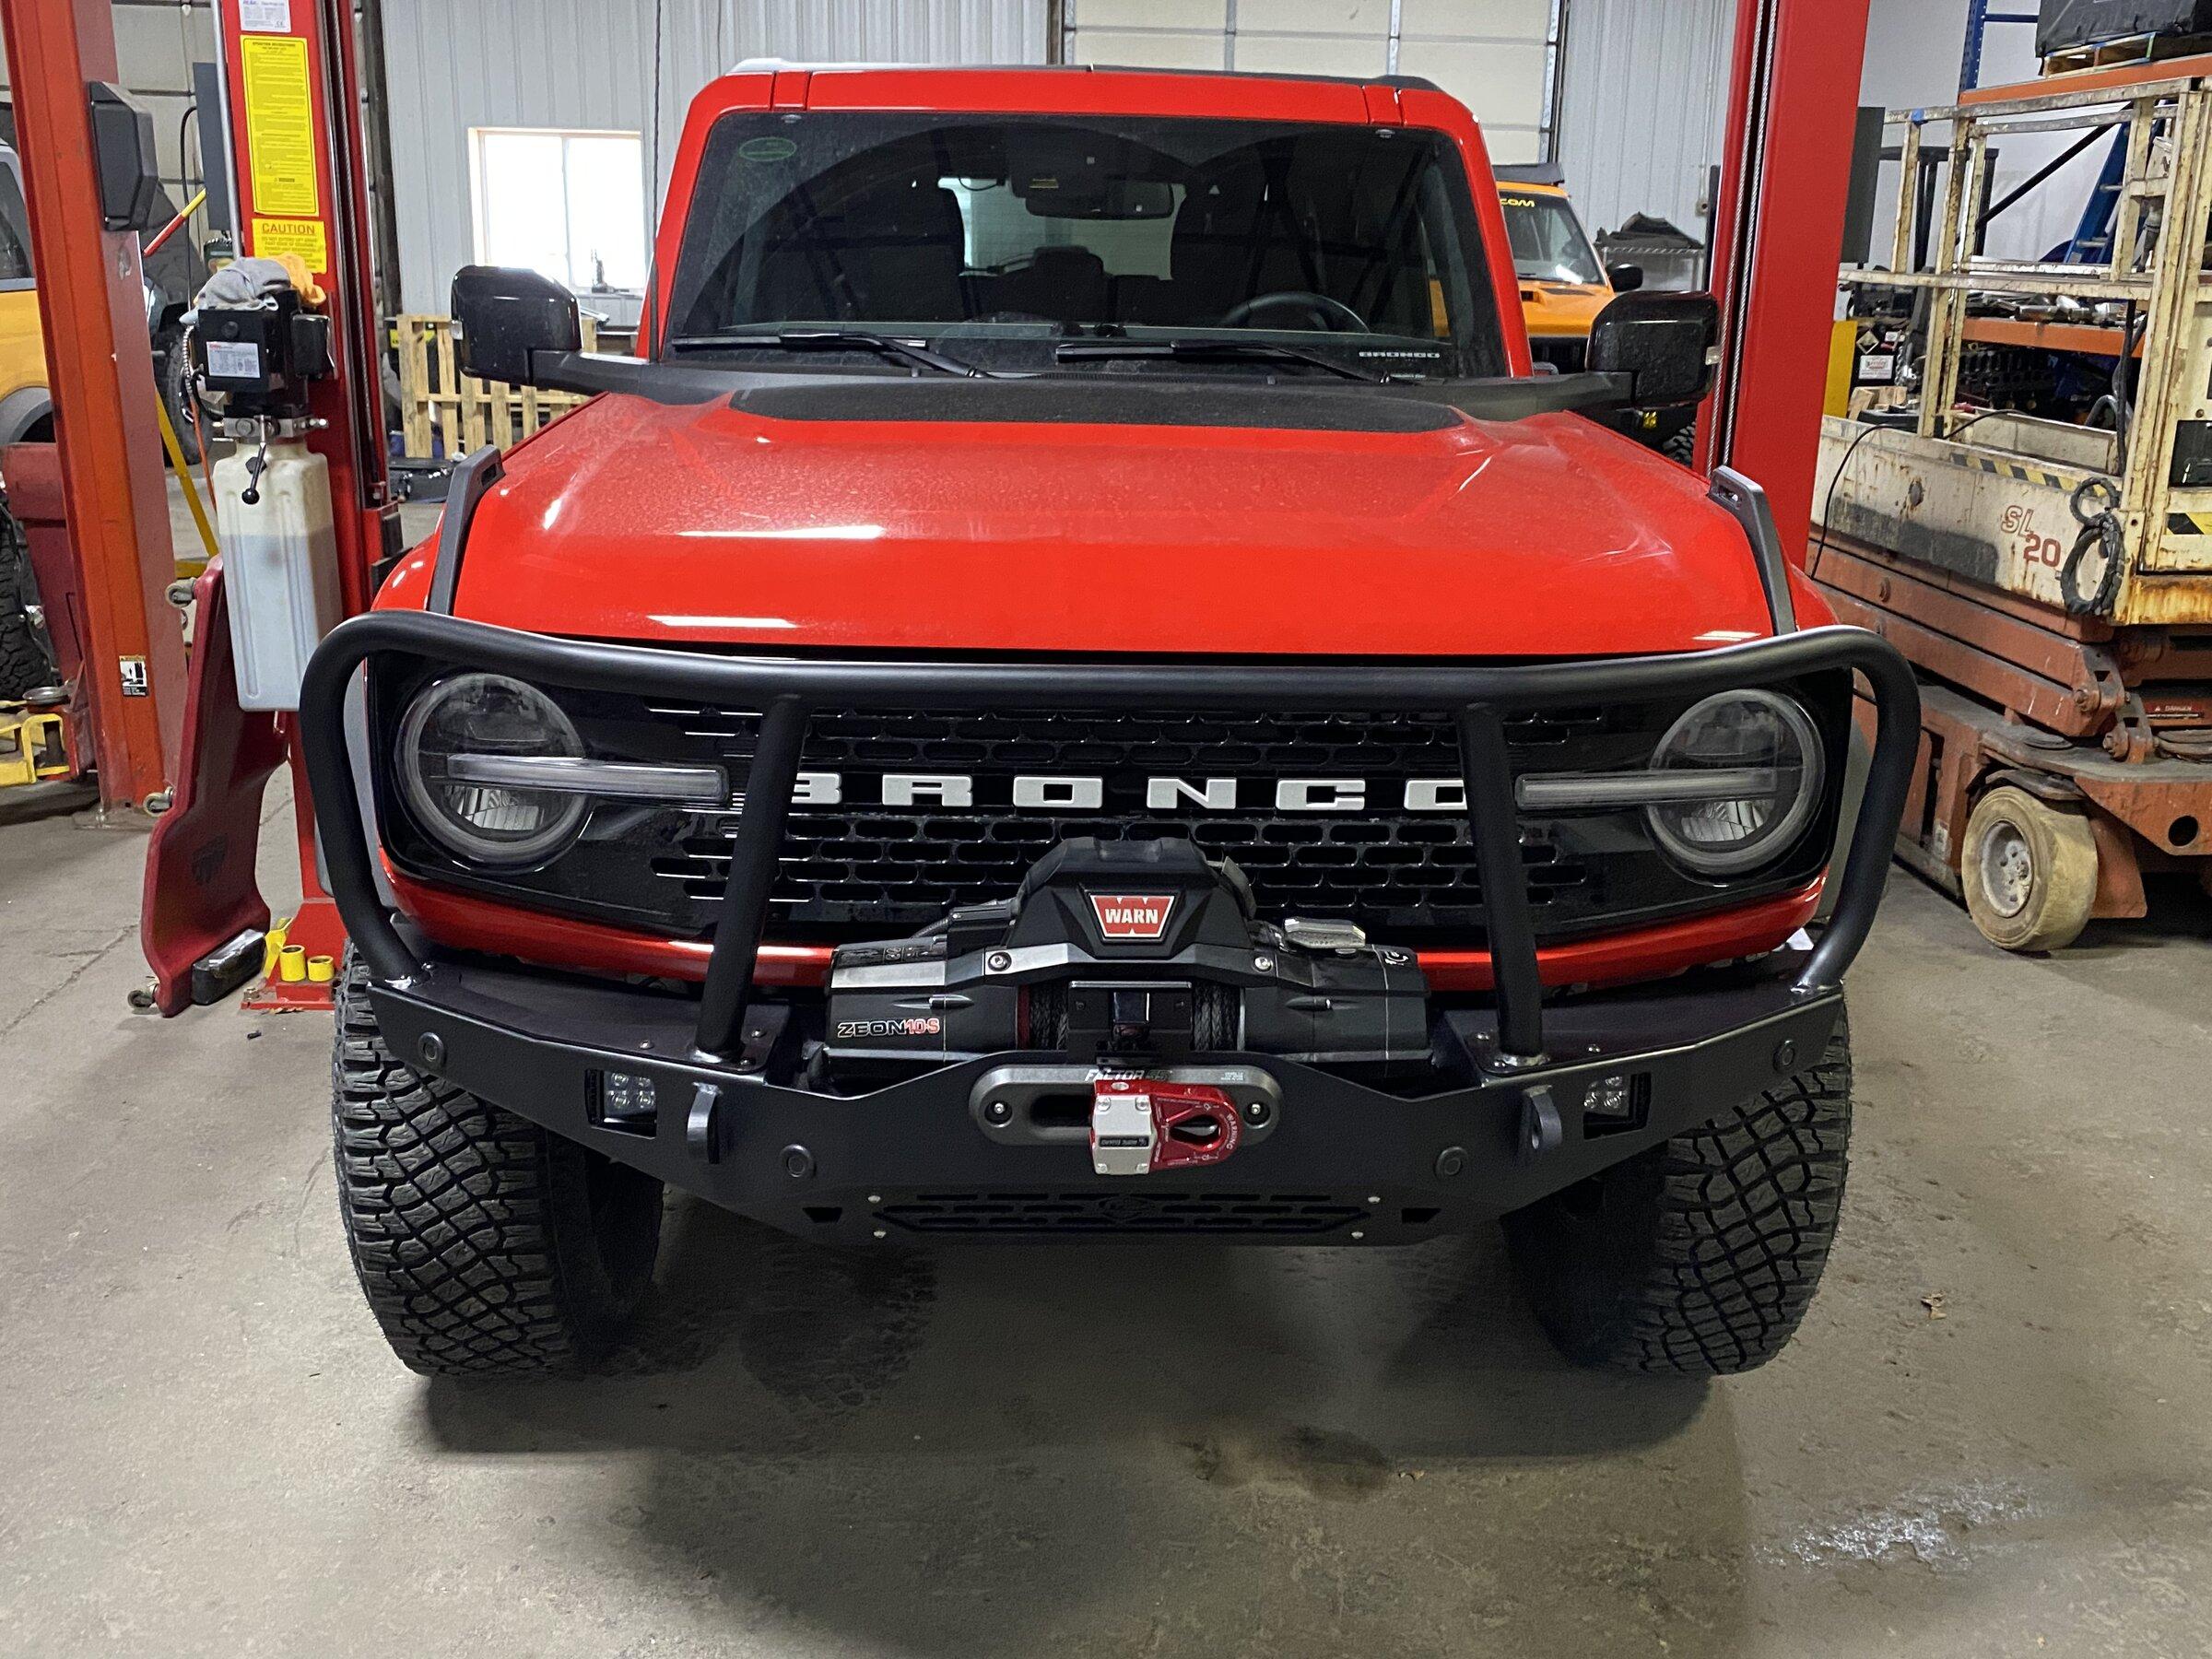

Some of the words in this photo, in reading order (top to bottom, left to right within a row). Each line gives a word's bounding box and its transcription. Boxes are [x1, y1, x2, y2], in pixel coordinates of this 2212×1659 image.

[262, 223, 315, 234] CAUTION
[2001, 505, 2034, 538] SL
[2023, 533, 2062, 568] 20
[791, 772, 1468, 810] BRONCO
[1104, 908, 1159, 924] WARN
[1226, 1112, 1239, 1150] WARNING
